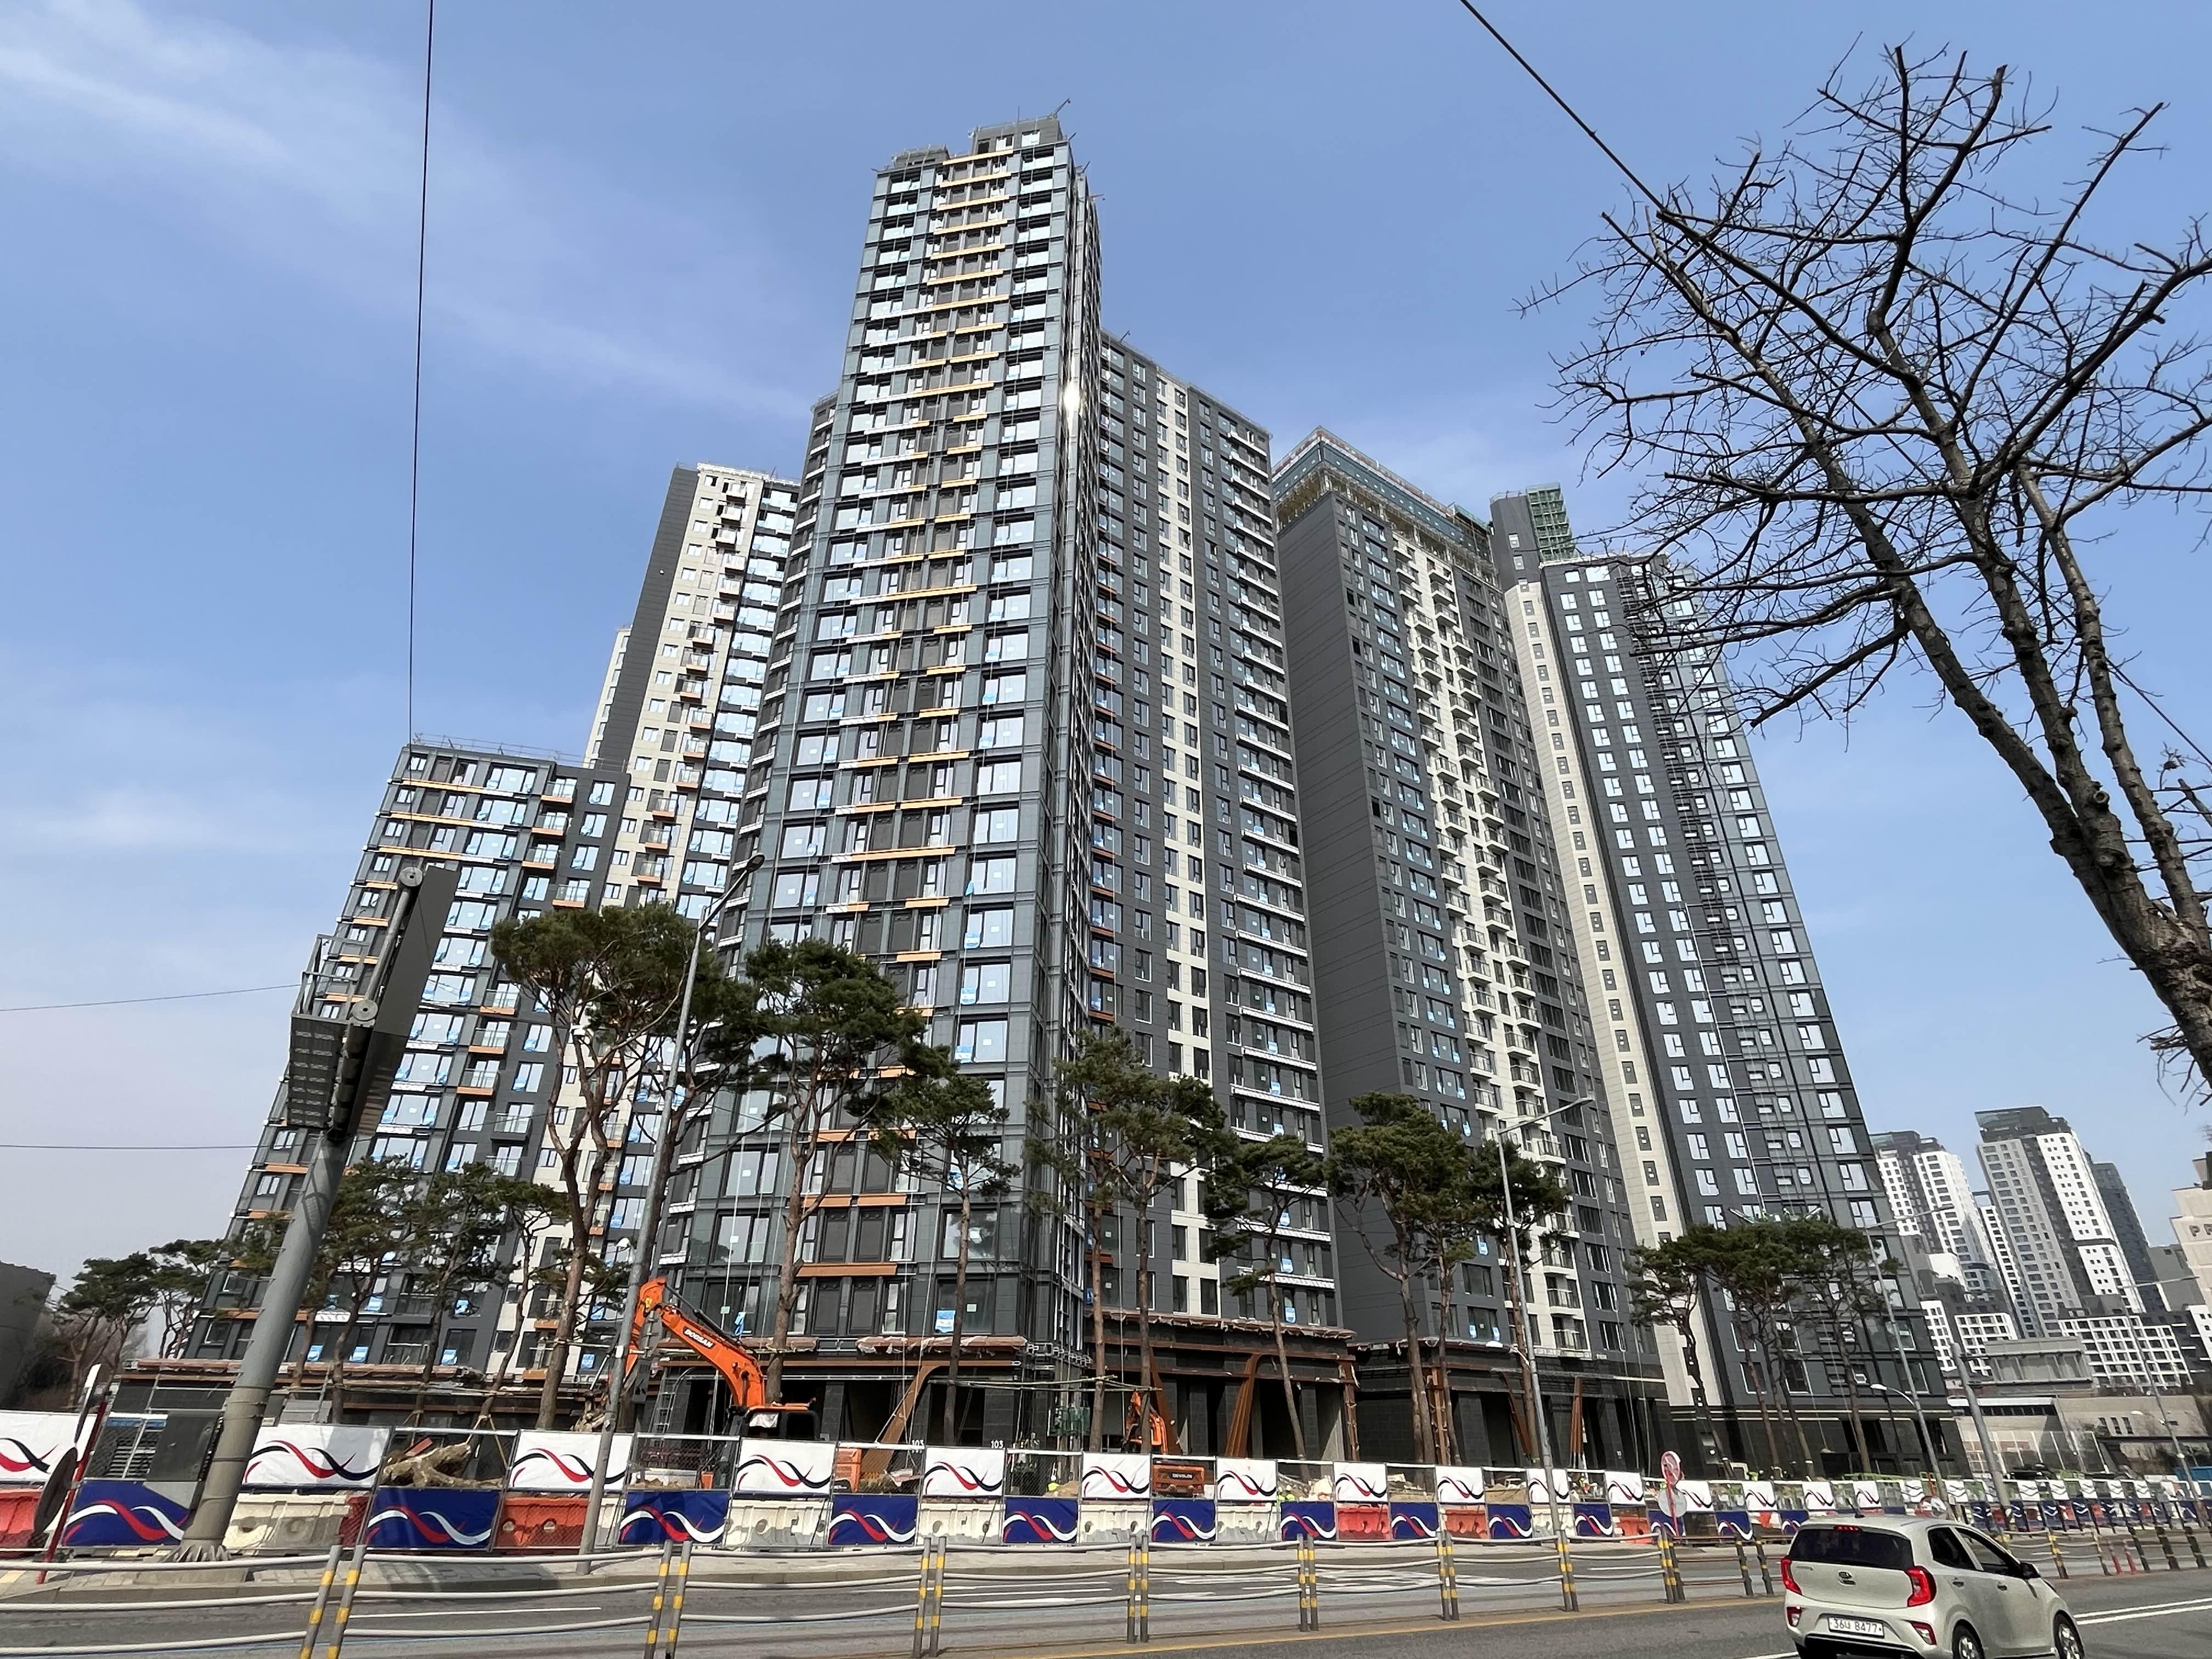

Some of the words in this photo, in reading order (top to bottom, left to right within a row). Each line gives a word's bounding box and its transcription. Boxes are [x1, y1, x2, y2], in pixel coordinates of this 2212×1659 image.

[684, 1329, 713, 1348] DOOSAN
[991, 1440, 1003, 1449] 103
[1854, 1621, 1877, 1633] 8477
